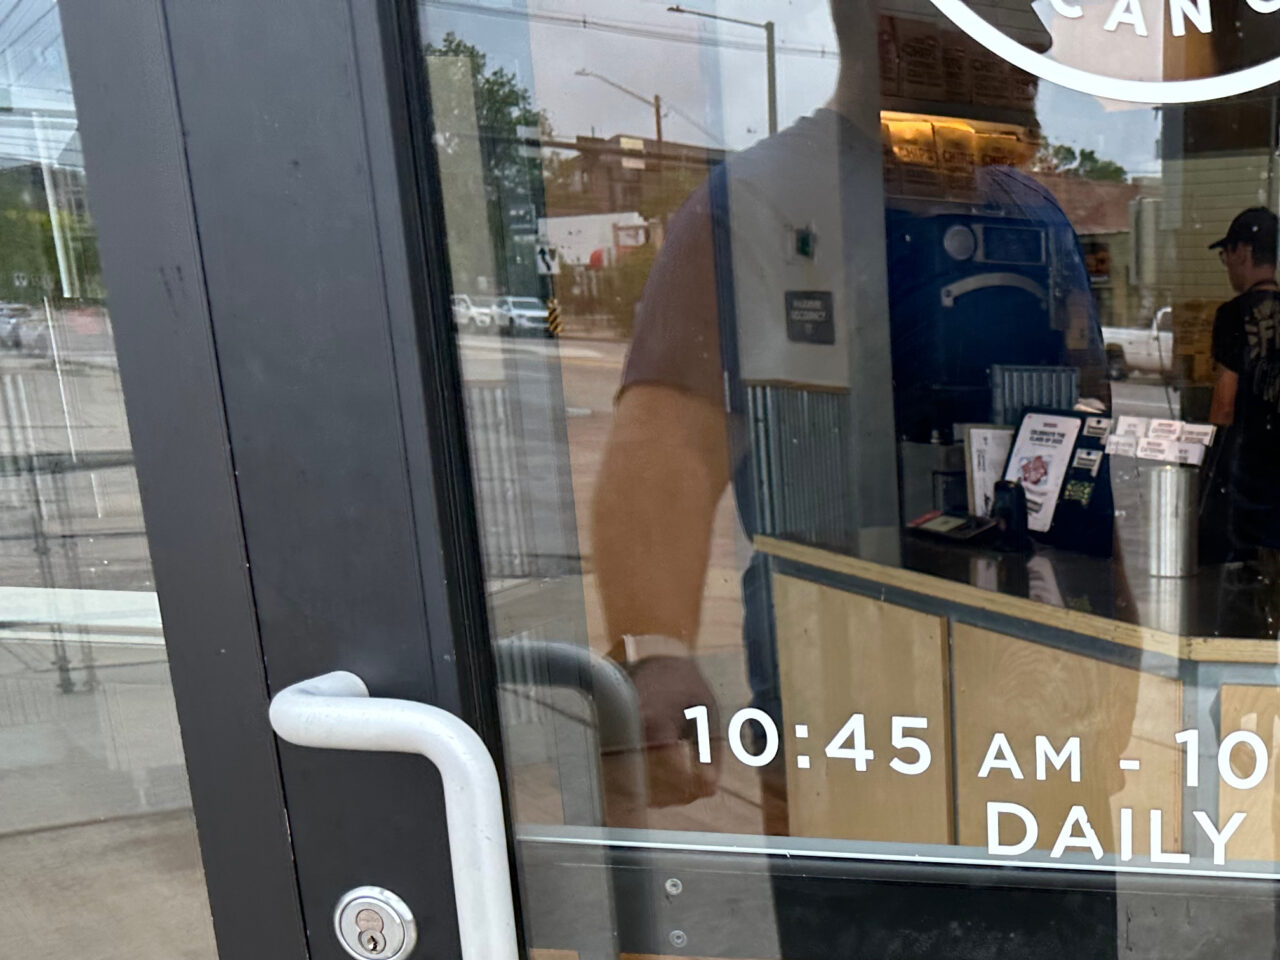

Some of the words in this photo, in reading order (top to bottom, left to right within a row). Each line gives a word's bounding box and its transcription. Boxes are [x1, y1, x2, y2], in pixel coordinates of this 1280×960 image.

[683, 704, 932, 776] 10:45
[977, 732, 1082, 783] AM
[986, 801, 1248, 867] DAILY
